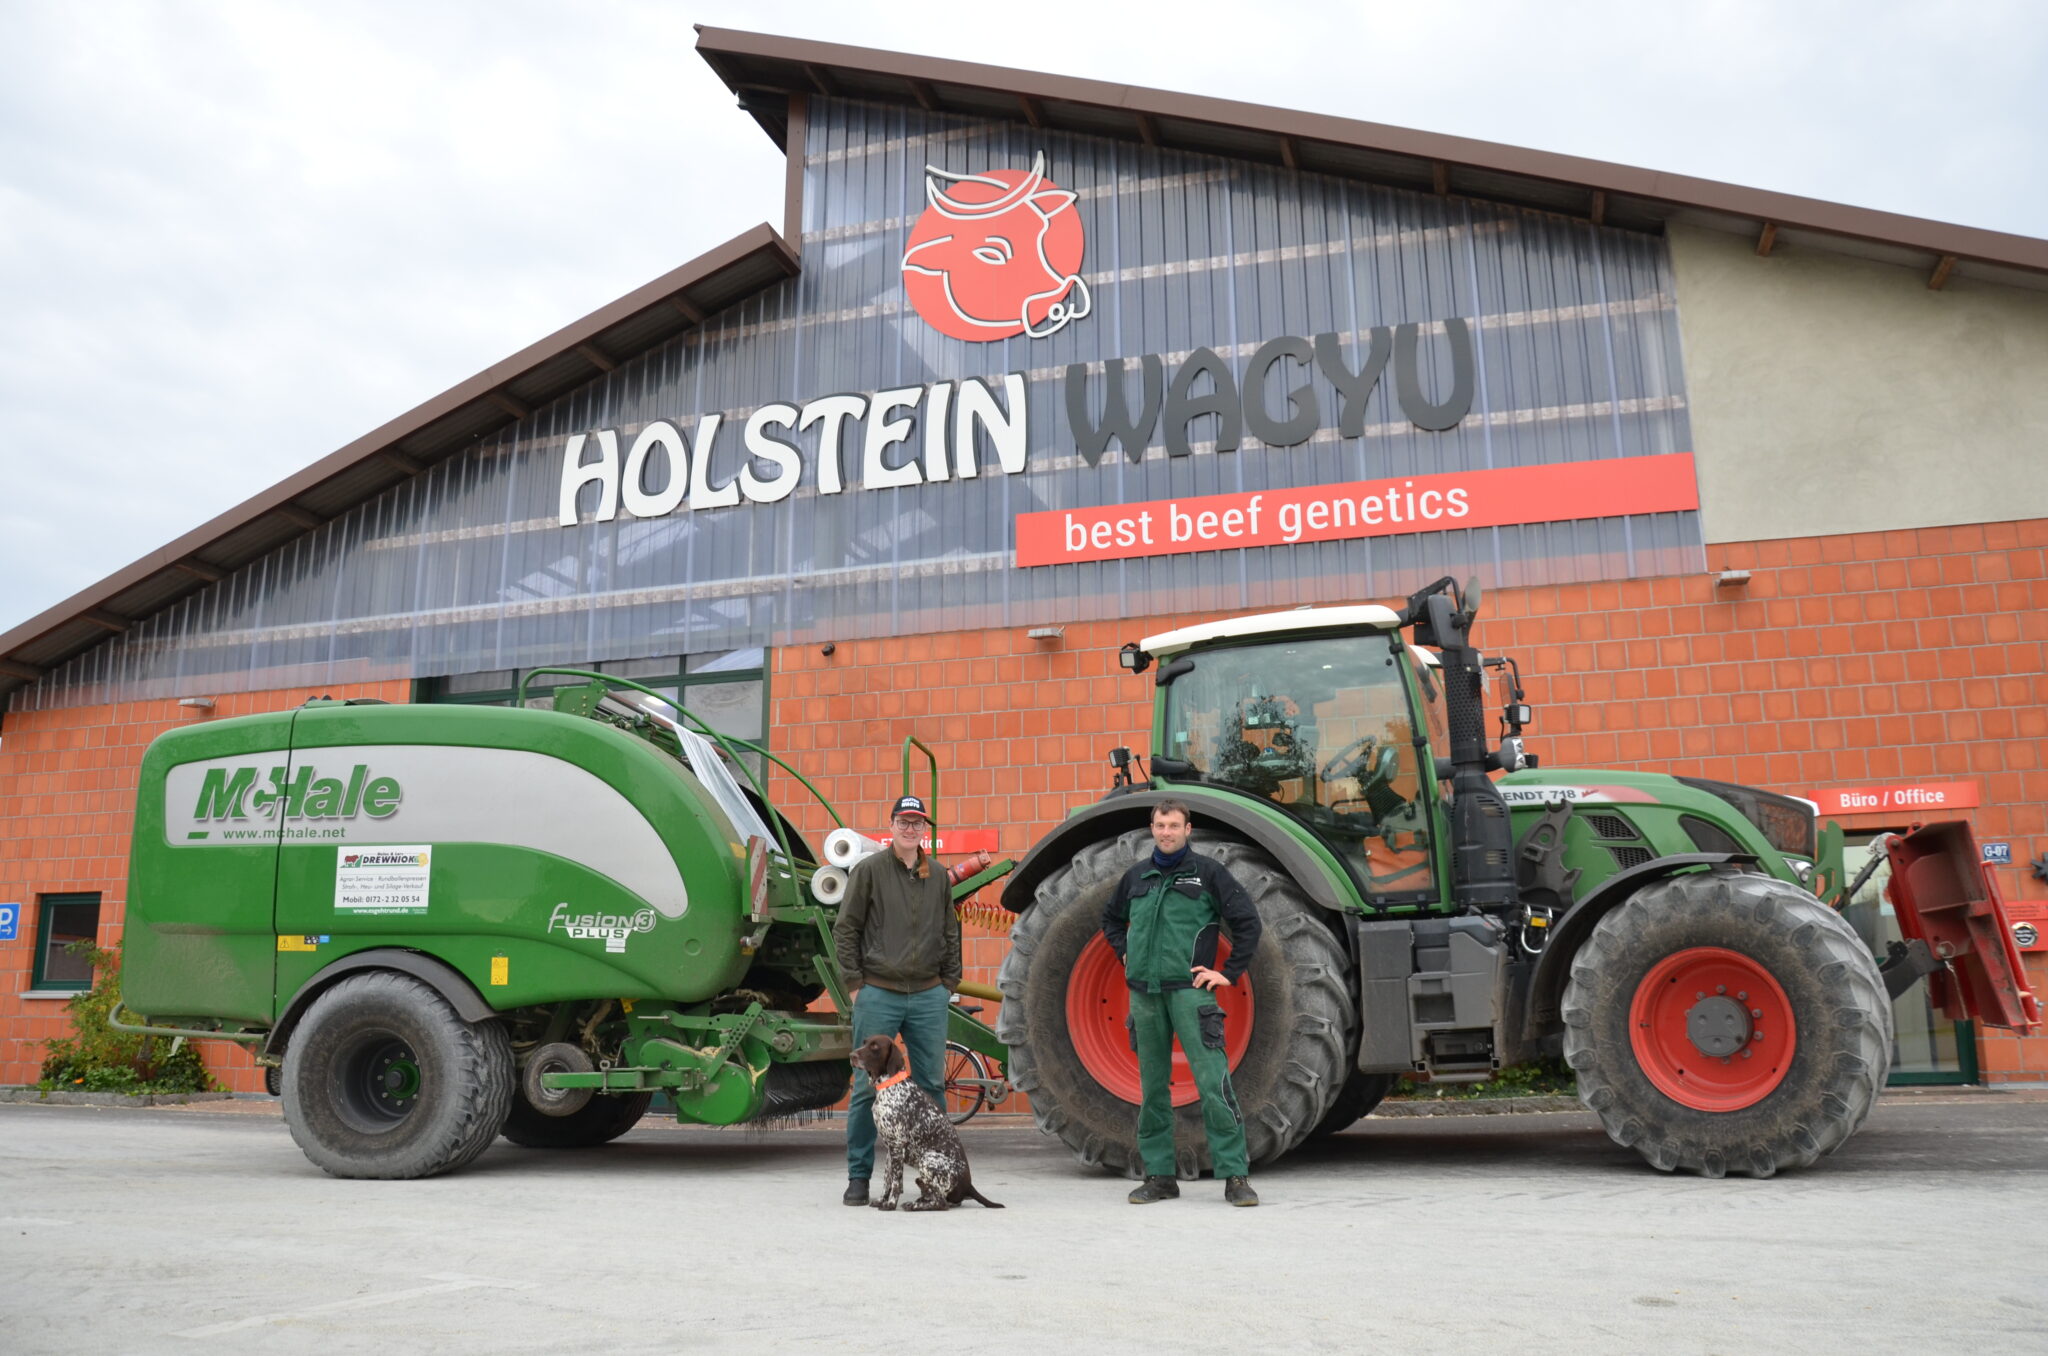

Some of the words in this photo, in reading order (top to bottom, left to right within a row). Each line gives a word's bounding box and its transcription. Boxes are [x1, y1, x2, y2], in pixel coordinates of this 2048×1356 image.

[559, 371, 1027, 527] HOLSTEIN
[1064, 318, 1475, 468] WAGYU
[1065, 512, 1154, 551] best
[1170, 495, 1262, 542] beef
[1278, 481, 1470, 542] genetics
[194, 765, 401, 818] McHale
[1501, 790, 1545, 801] ENDT
[1549, 789, 1577, 800] 718
[1839, 792, 1878, 807] Büro
[1883, 792, 1889, 806] /
[1894, 789, 1945, 804] Office
[223, 827, 346, 839] www.mchale.net
[1984, 845, 2008, 857] G-07
[362, 855, 415, 864] DREWNIOK
[342, 896, 363, 904] Mobil:
[572, 928, 625, 938] PLUS
